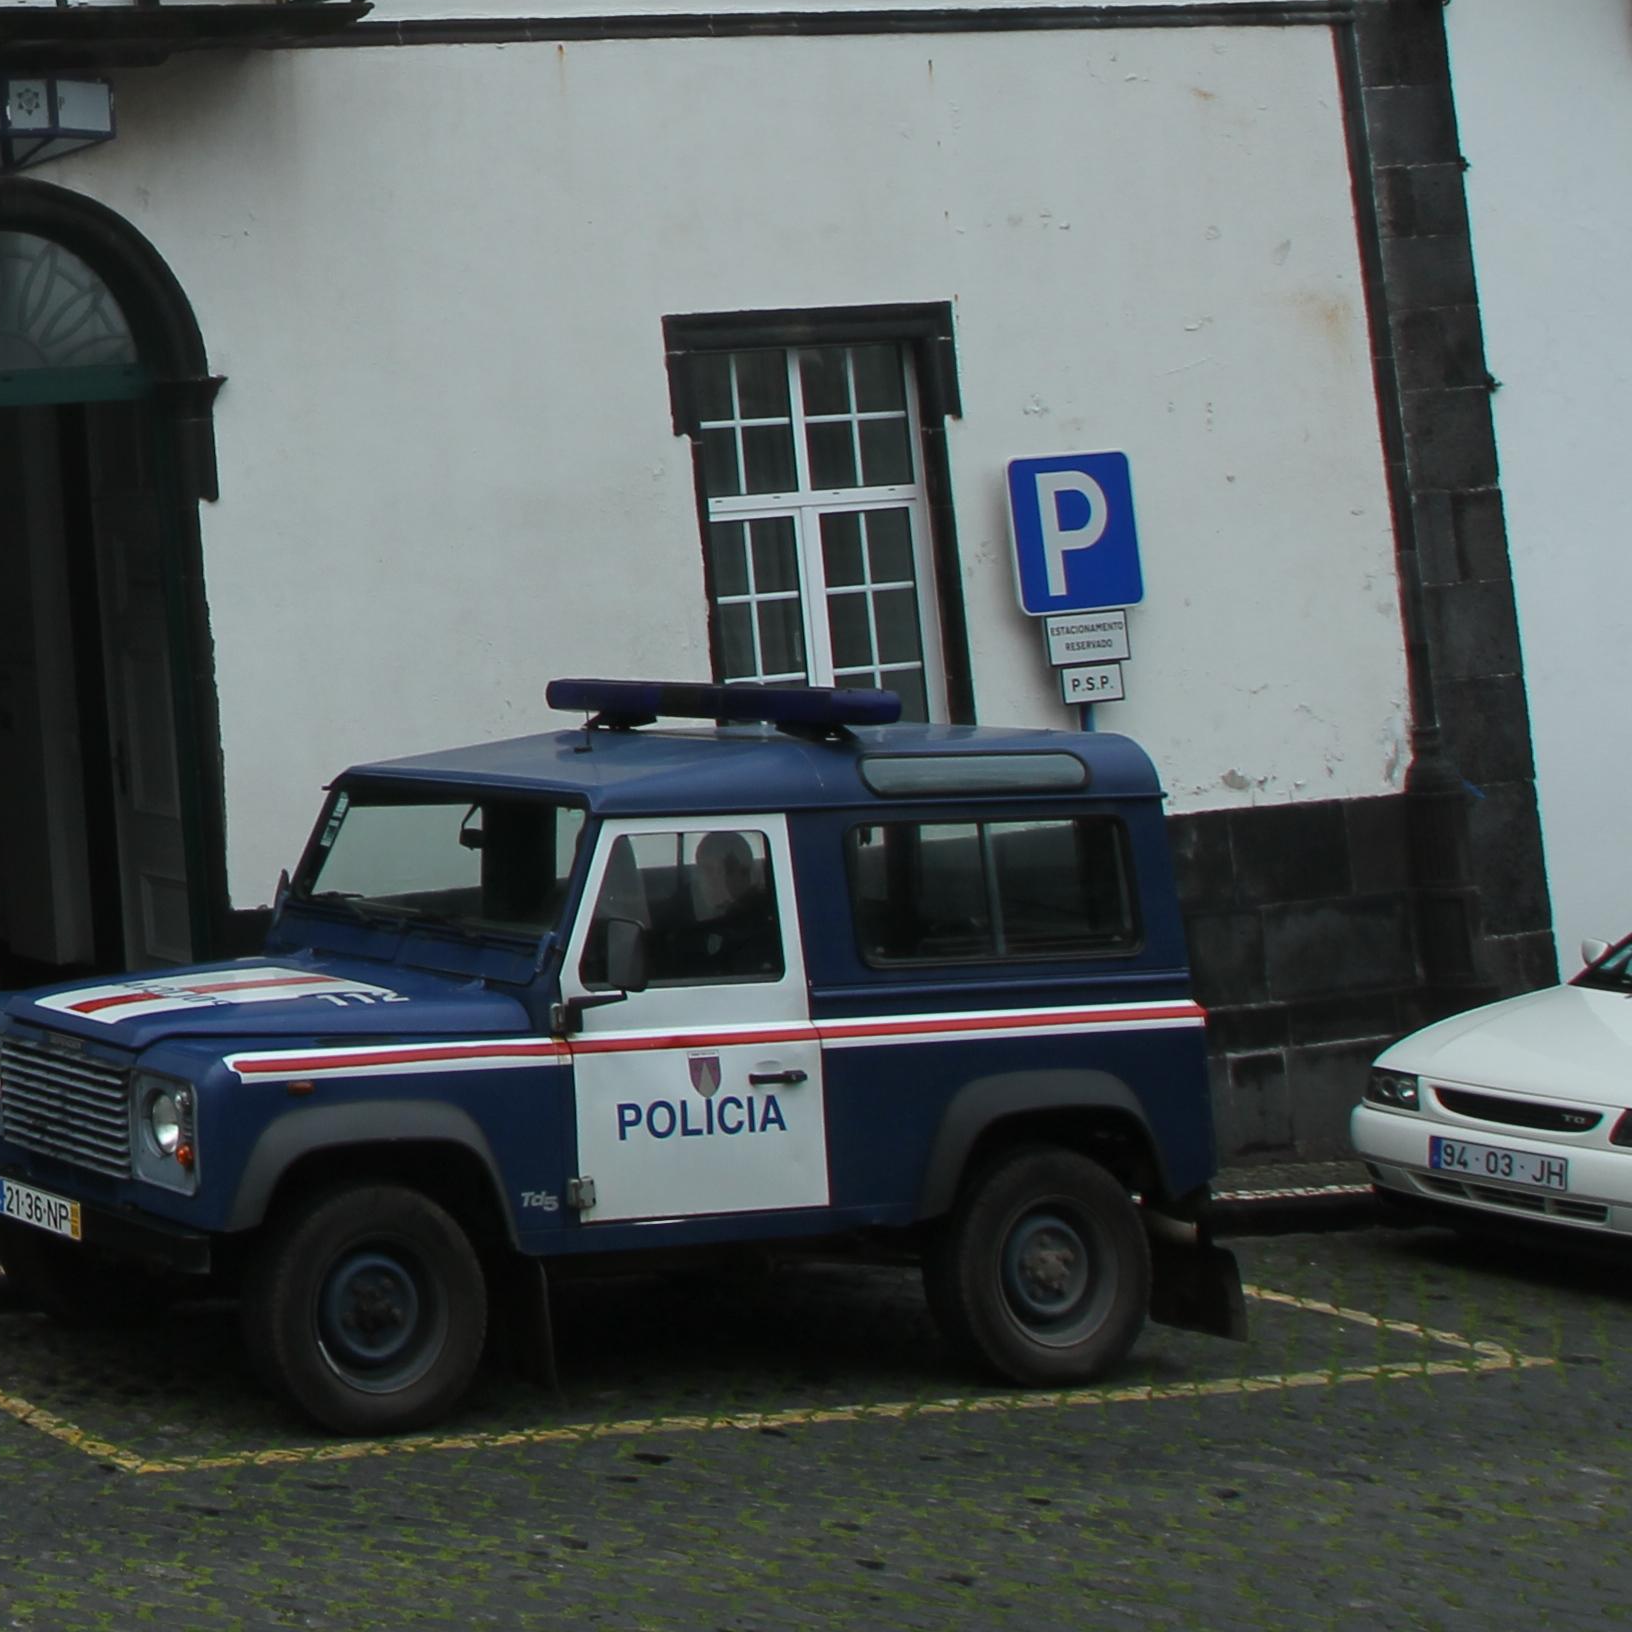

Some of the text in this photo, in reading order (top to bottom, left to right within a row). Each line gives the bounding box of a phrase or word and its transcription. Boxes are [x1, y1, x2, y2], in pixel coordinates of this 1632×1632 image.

[1034, 470, 1107, 597] P
[1050, 620, 1124, 637] ESTACIONAMENTO
[1065, 638, 1113, 652] RESERVADO
[1071, 674, 1115, 693] P.S.P.
[616, 1093, 788, 1142] POLICIA
[521, 1190, 559, 1212] Td5
